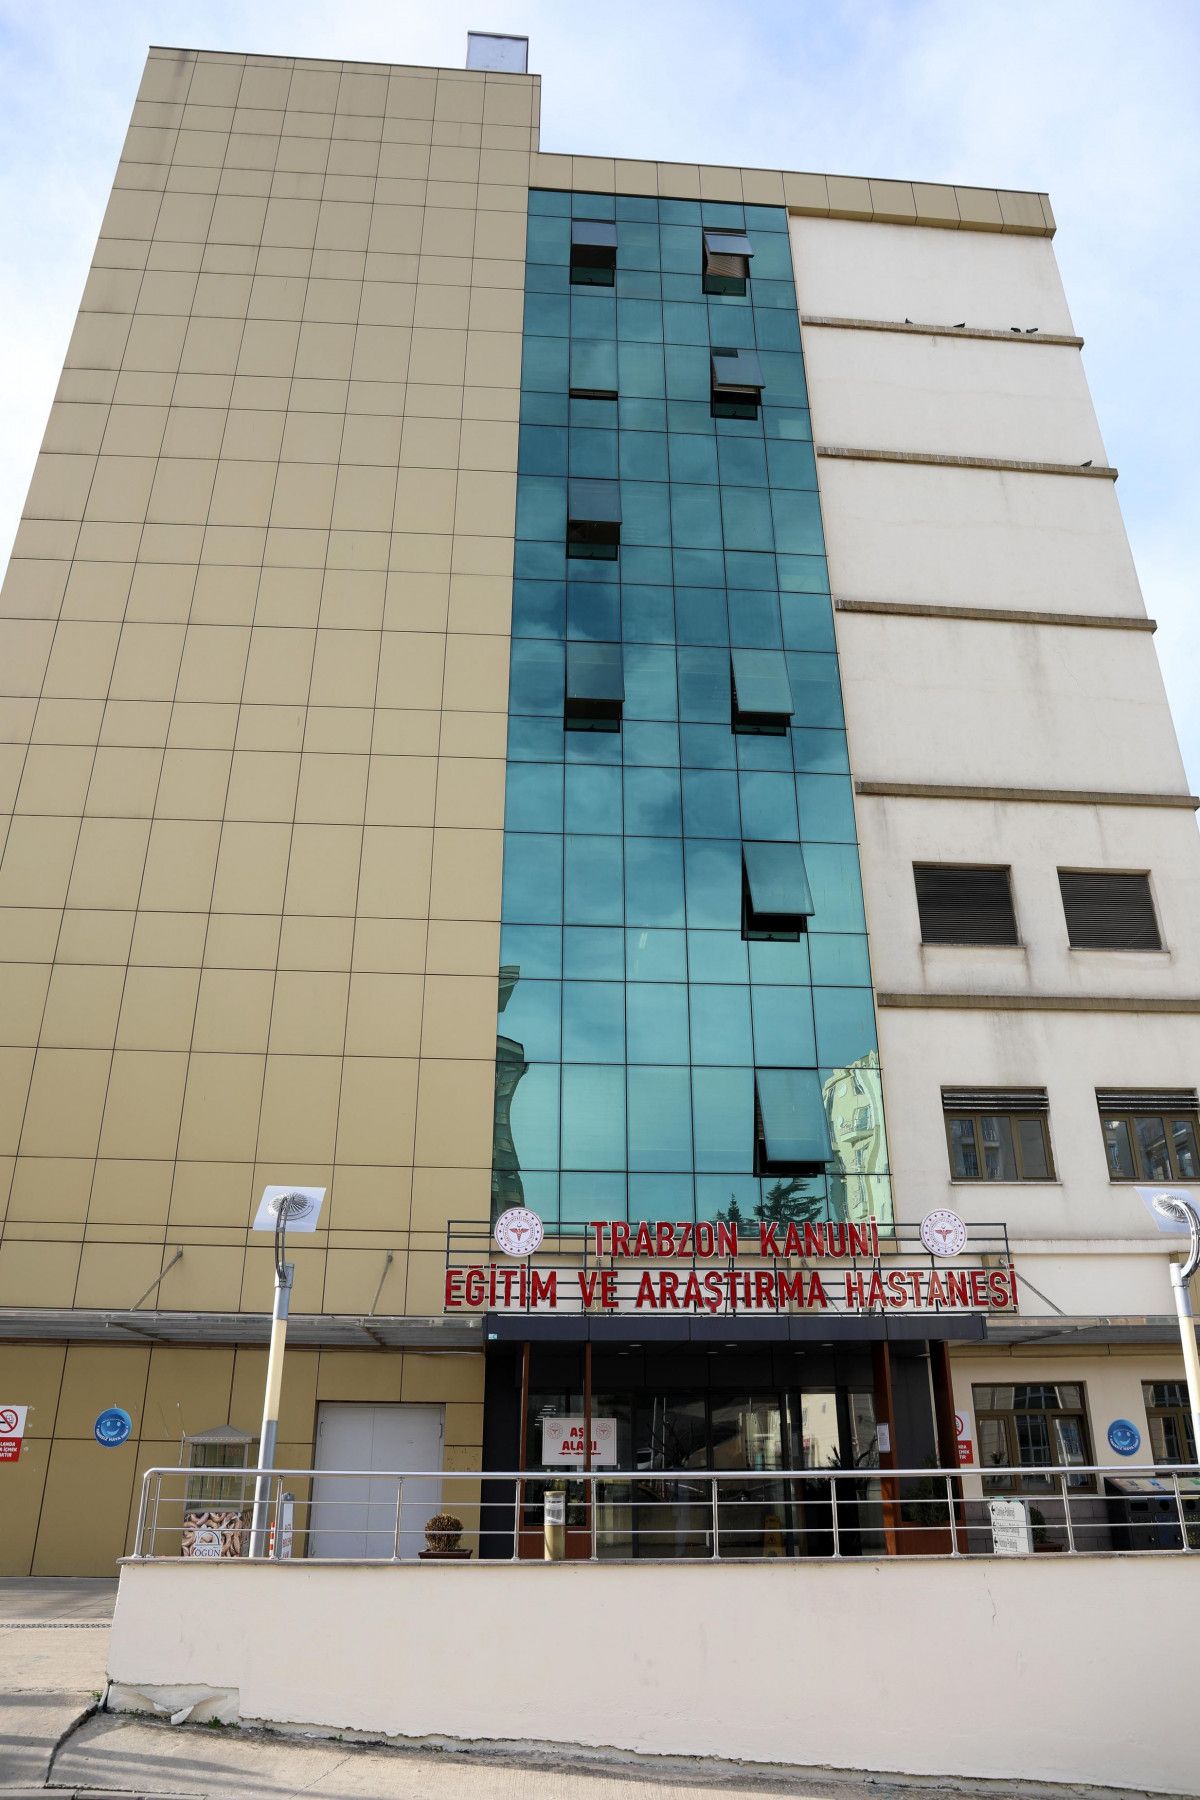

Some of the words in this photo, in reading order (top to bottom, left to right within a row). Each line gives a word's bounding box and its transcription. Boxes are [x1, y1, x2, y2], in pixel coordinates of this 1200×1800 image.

[589, 1220, 739, 1259] TRABZON
[759, 1215, 880, 1259] KANUNİ
[444, 1262, 558, 1308] EĞİTİM
[577, 1271, 619, 1308] VE
[635, 1270, 828, 1314] ARAŞTIRMA
[844, 1262, 1019, 1308] HASTANESİ
[562, 1440, 597, 1450] ALAI
[570, 1427, 584, 1439] AŞ
